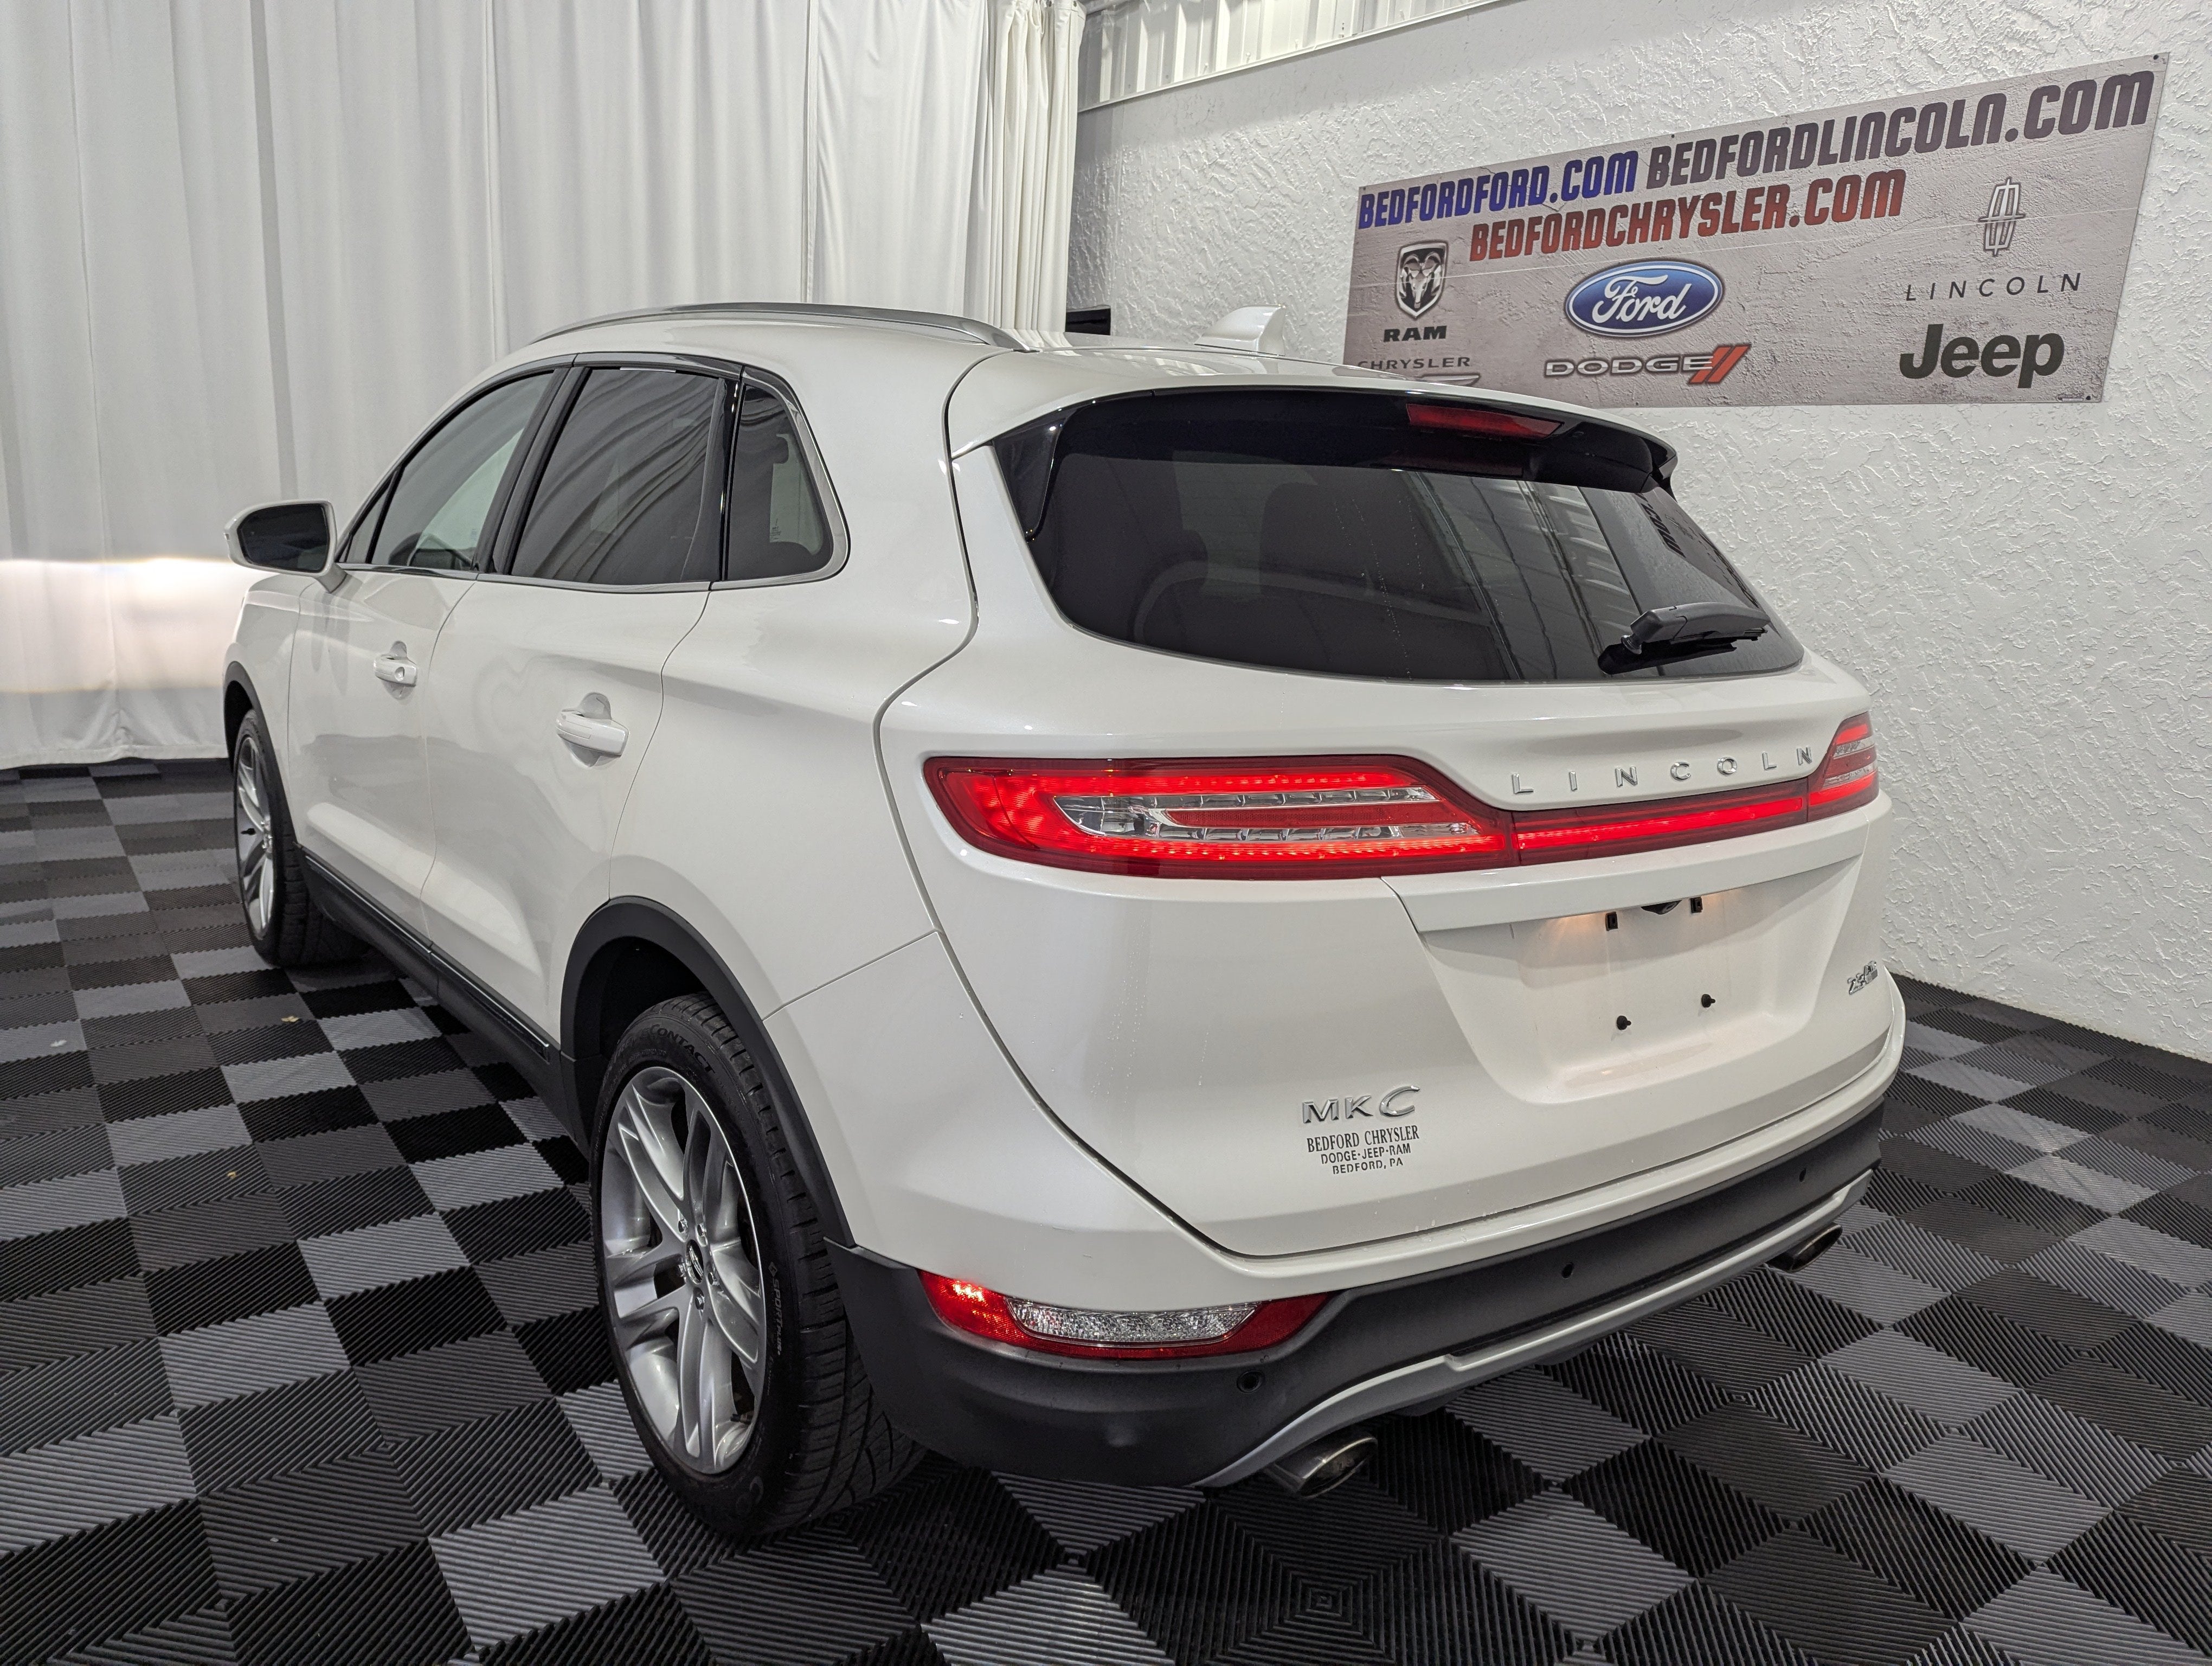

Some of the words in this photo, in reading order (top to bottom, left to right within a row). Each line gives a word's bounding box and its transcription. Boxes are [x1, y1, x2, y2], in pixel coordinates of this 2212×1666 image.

[1358, 151, 1638, 229] BEDFORDFORD.COM
[1647, 71, 2155, 190] BEDFORDLINCOLN.COM
[1469, 169, 1906, 262] BEDFORDCHRYSLER.COM
[1592, 274, 1692, 324] Ford
[1905, 273, 2081, 301] LINCOLN
[1383, 325, 1447, 342] RAM
[1545, 356, 1714, 376] DODGE
[1900, 324, 2065, 388] Jeep
[1512, 746, 1813, 794] LINCOLN
[1302, 1085, 1420, 1124] MKC
[1307, 1132, 1359, 1153] BEDFORD
[1364, 1125, 1420, 1145] CHRYSLER
[1333, 1160, 1387, 1175] BEDFORD,
[1390, 1157, 1404, 1167] PA
